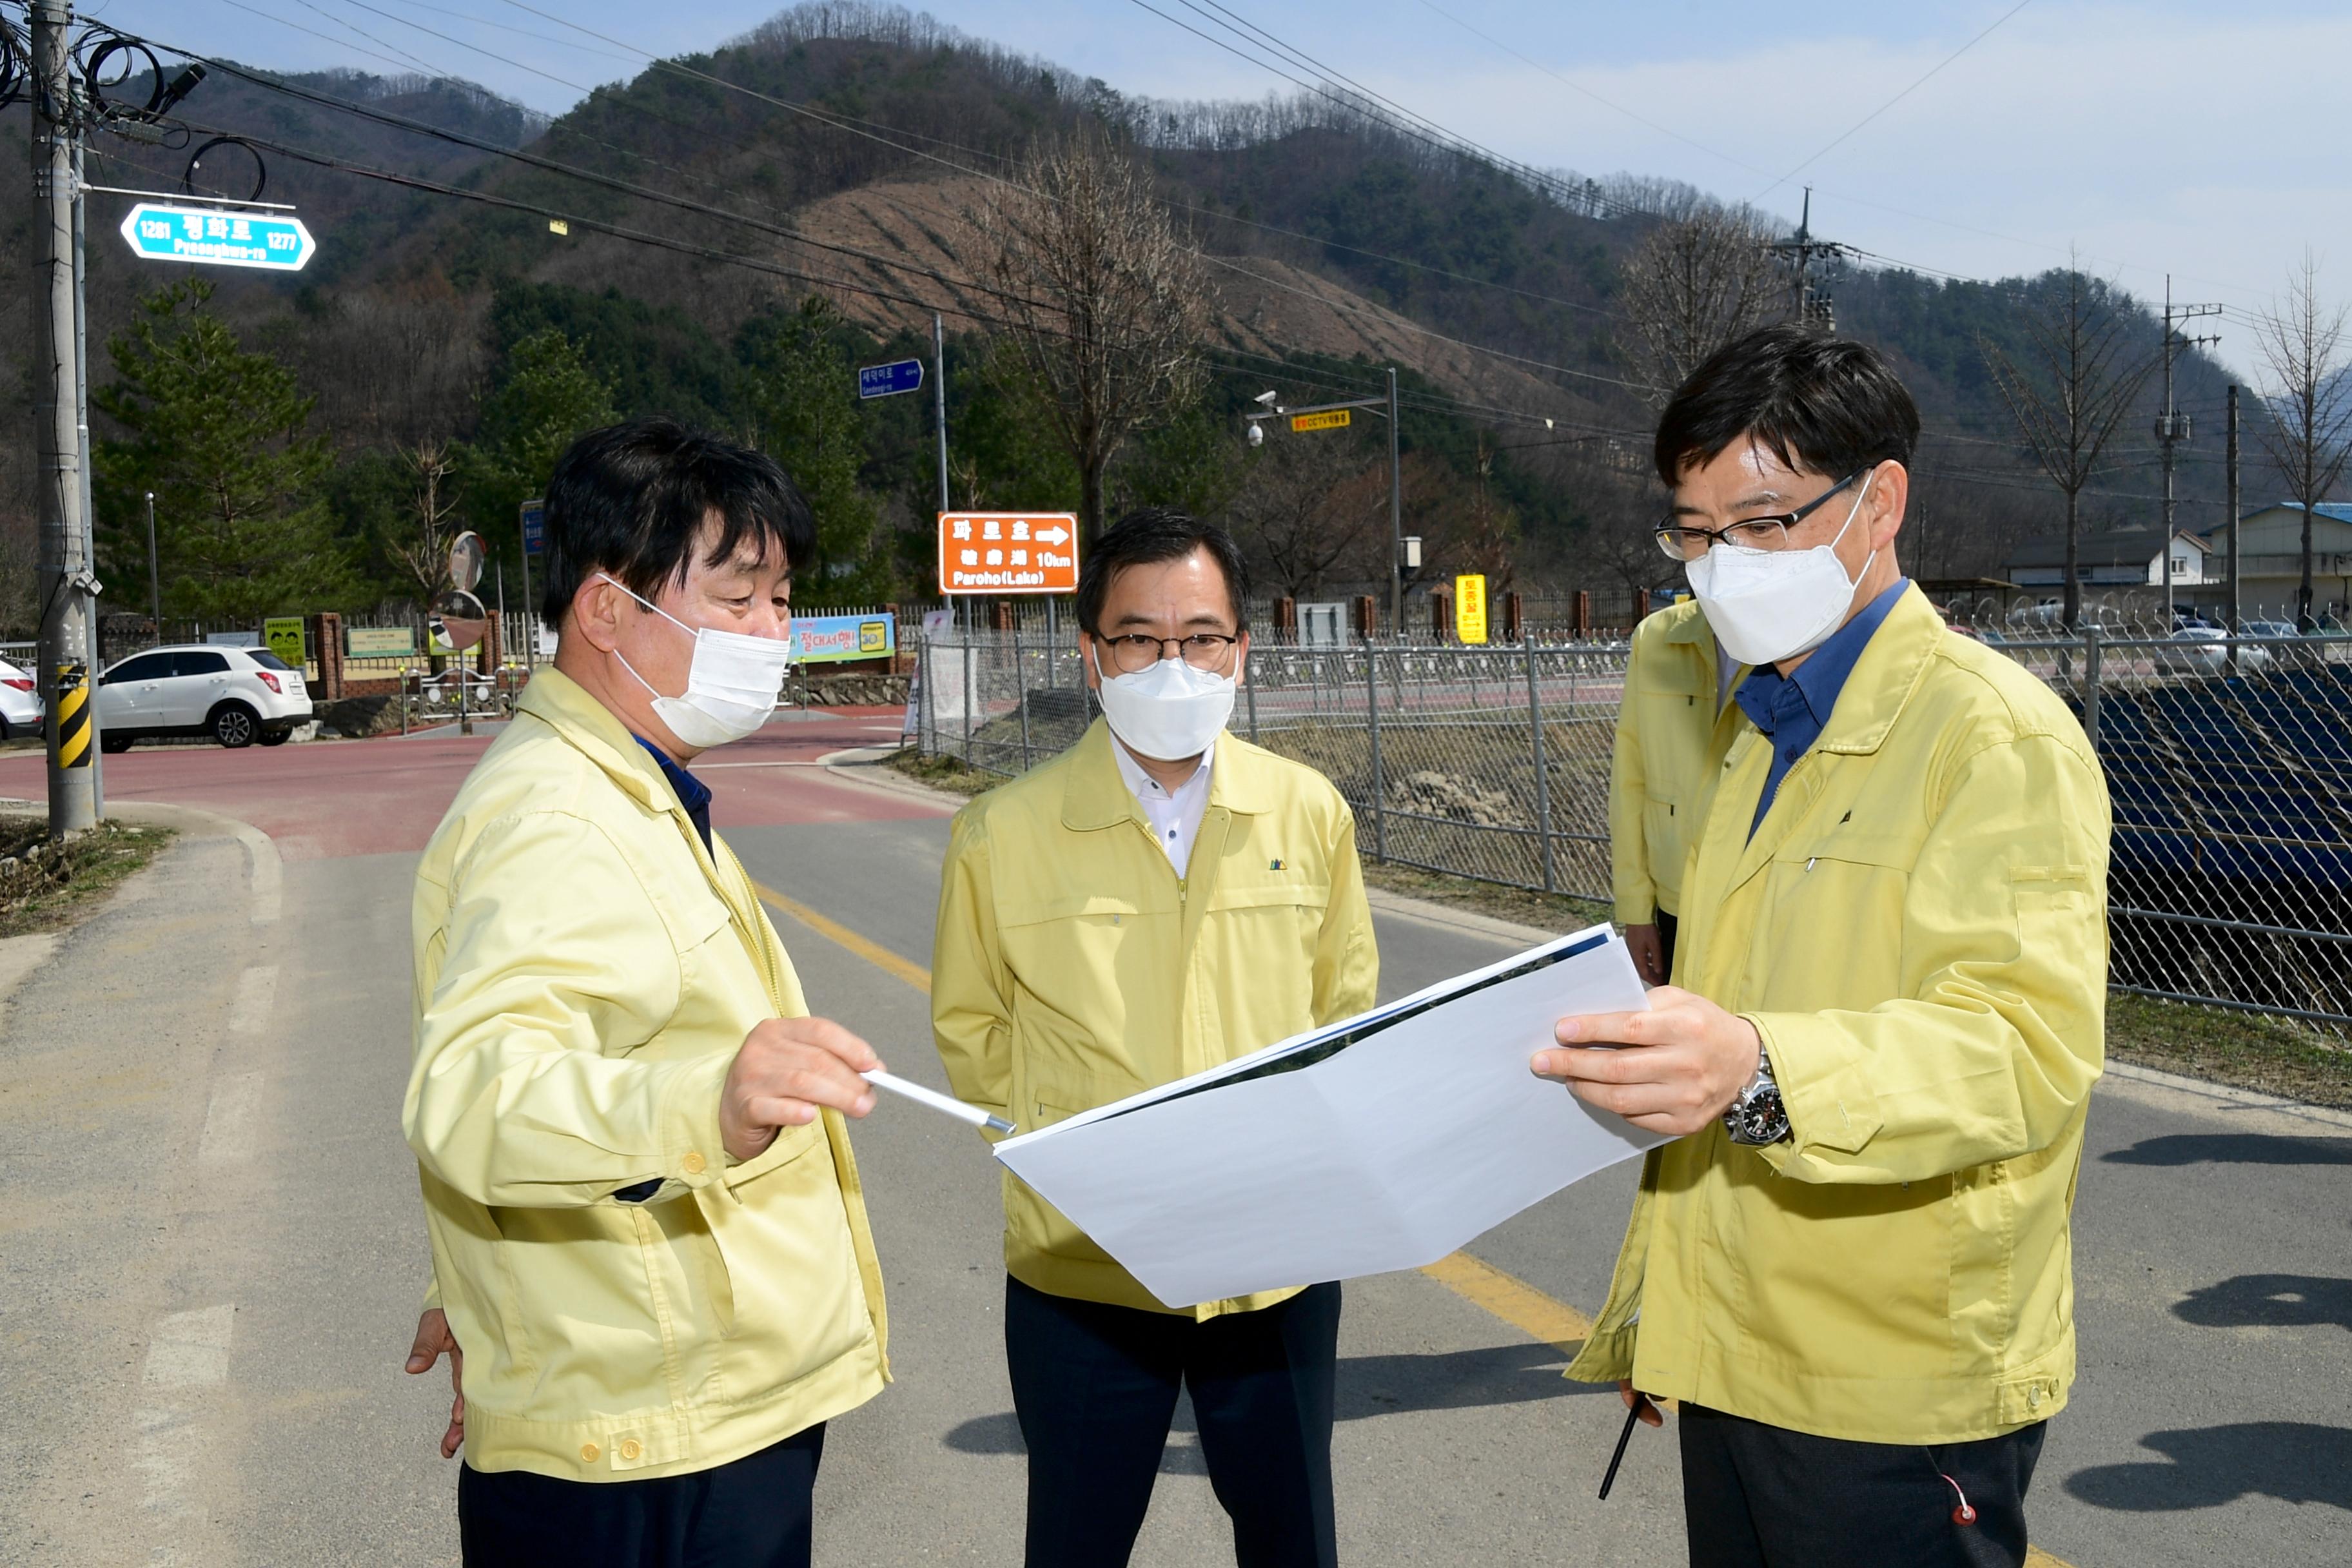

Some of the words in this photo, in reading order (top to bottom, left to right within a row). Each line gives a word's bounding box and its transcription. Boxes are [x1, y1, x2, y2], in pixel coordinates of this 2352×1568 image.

[140, 220, 171, 239] 1281
[183, 215, 252, 240] 평화로
[173, 239, 267, 260] Pyeonghwa-ro
[267, 232, 297, 251] 1277
[1036, 551, 1072, 567] 10km
